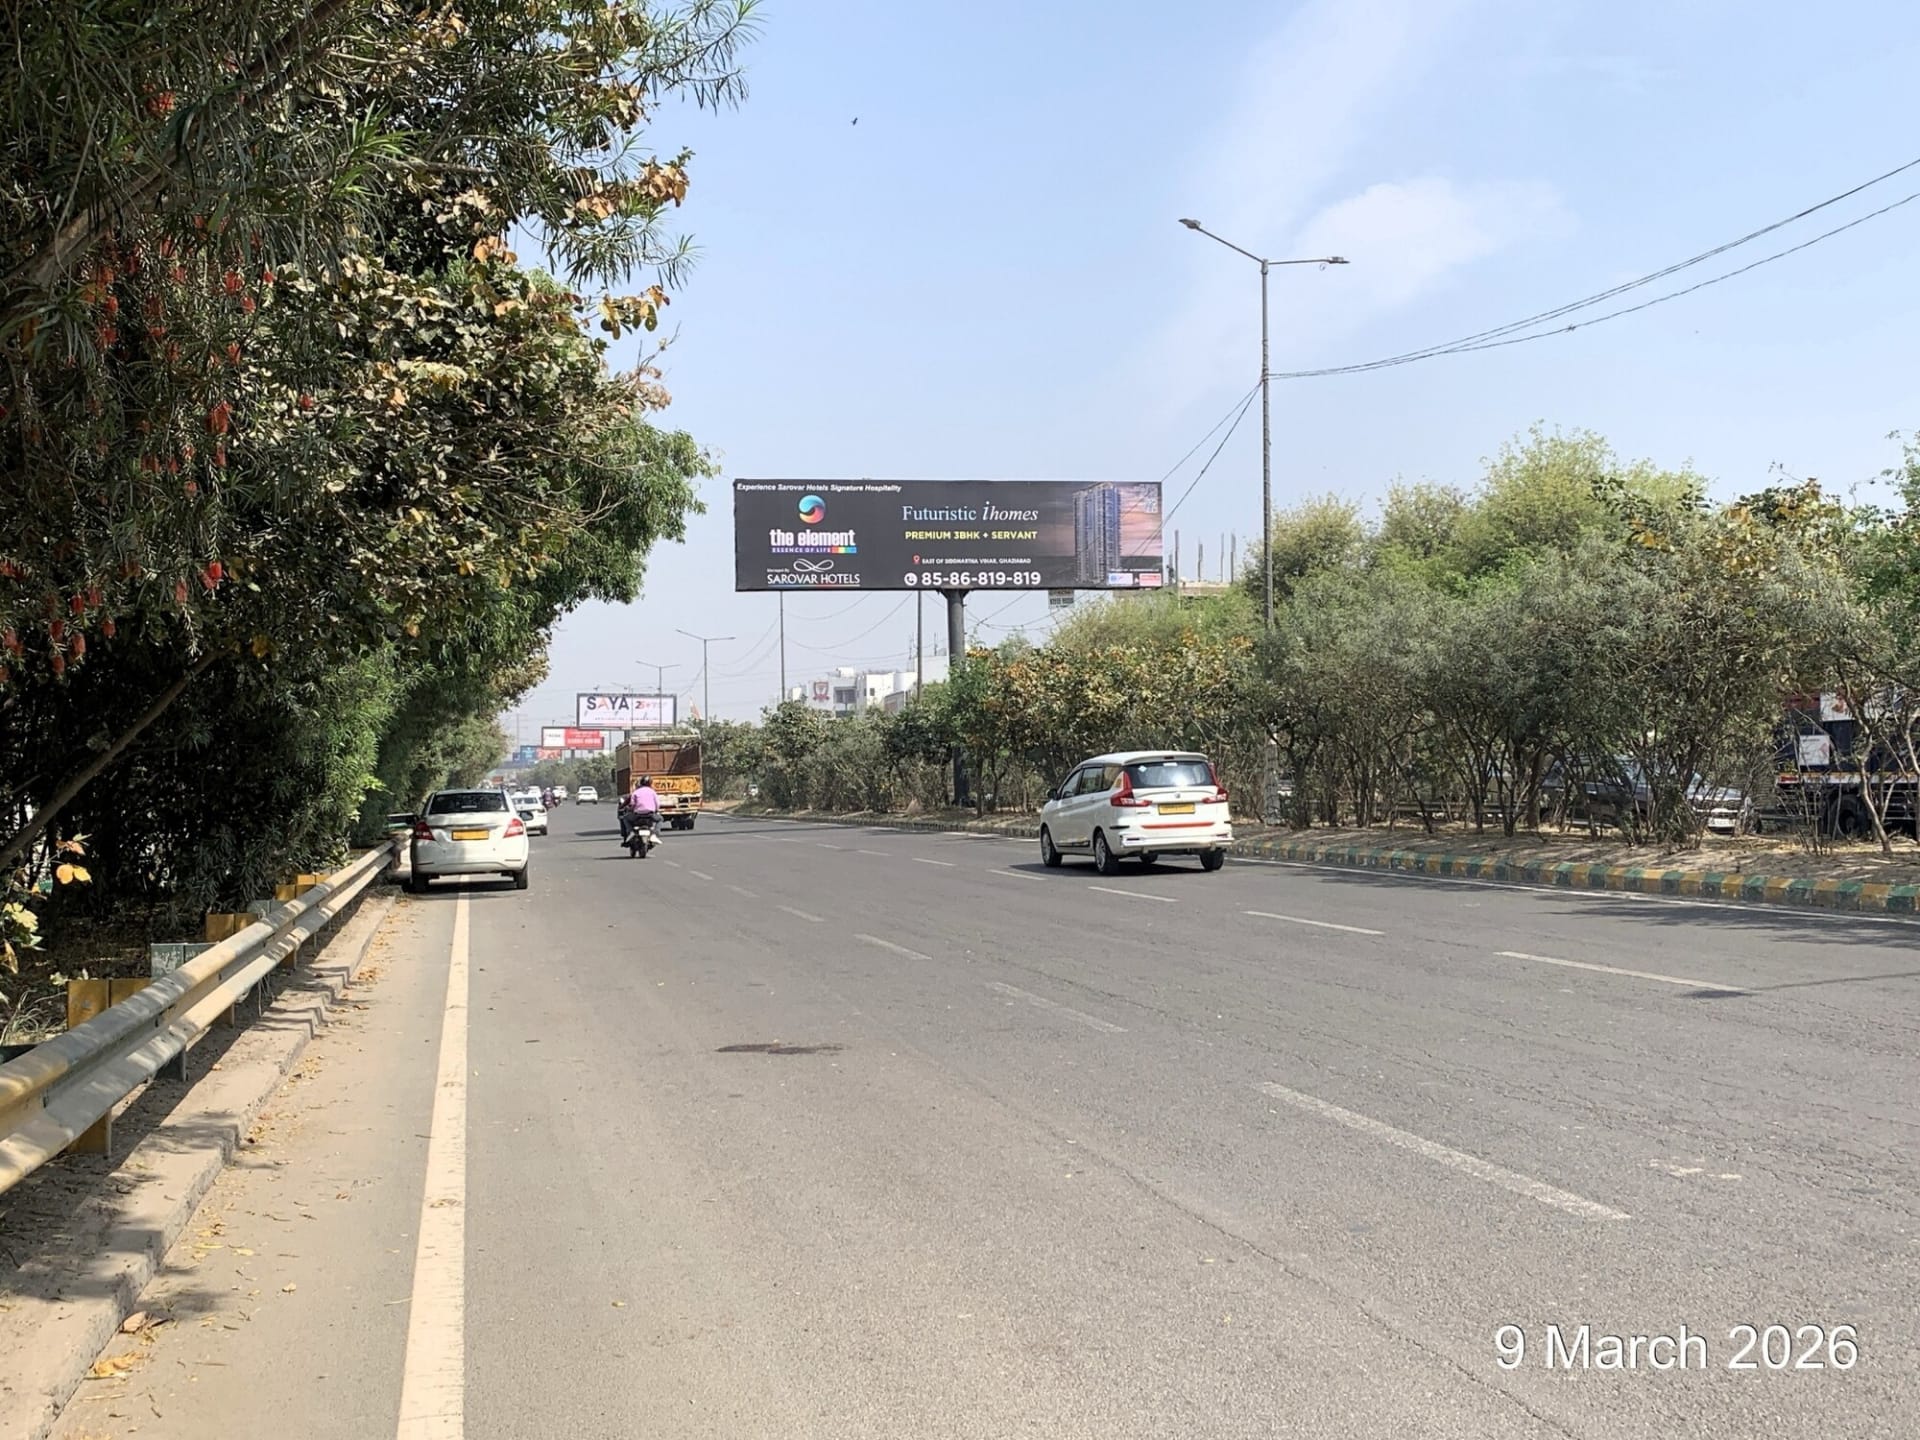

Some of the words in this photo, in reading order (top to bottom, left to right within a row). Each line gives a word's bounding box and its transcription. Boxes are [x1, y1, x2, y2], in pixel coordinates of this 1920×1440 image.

[902, 505, 977, 521] Futuristic
[982, 501, 1039, 521] ihomes
[769, 529, 794, 546] the
[797, 529, 856, 546] element
[905, 530, 951, 540] PREMIUM
[953, 530, 980, 540] 3BHK
[991, 530, 1038, 540] SERVANT
[767, 573, 818, 584] SAROVAR
[820, 573, 861, 584] HOTELS
[921, 571, 1041, 586] 85-86-819-819
[586, 696, 630, 710] SAYA
